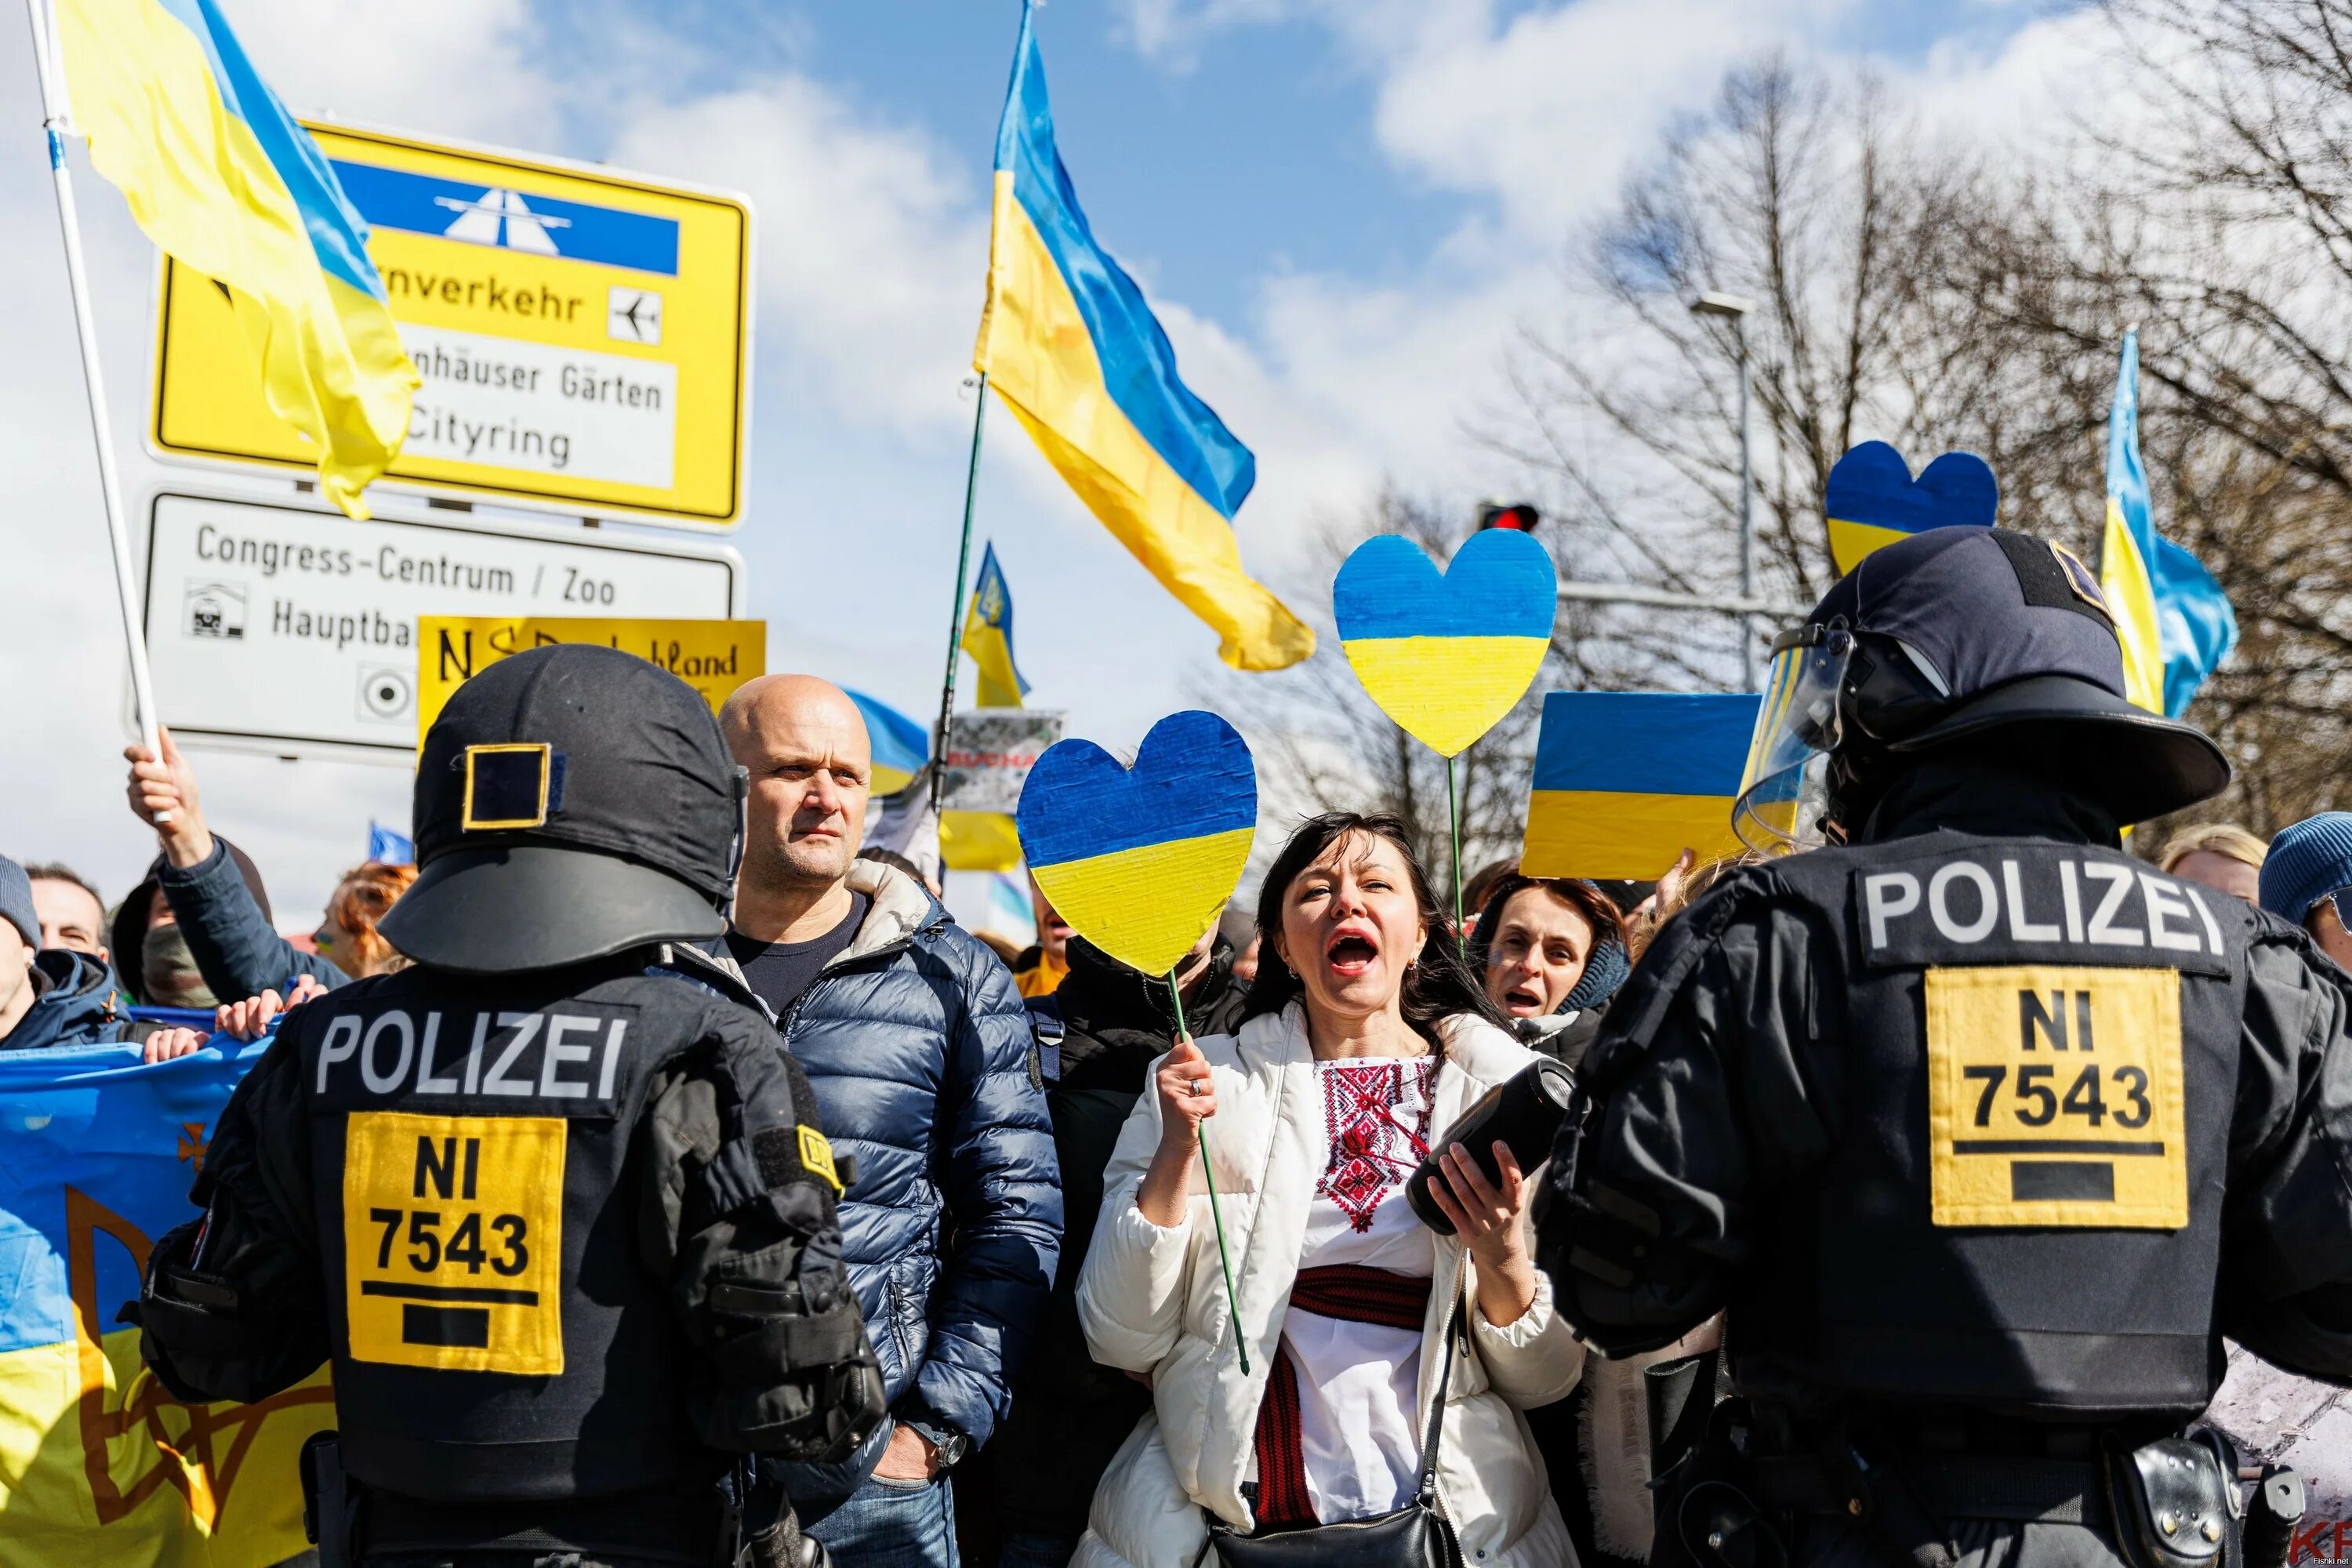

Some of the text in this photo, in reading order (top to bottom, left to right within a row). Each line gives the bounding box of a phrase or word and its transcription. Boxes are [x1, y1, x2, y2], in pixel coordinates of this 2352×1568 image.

[405, 345, 661, 410] nhäuser Gärten
[408, 404, 571, 470] Cityring
[198, 524, 515, 593] Congress-Centrum
[564, 567, 615, 605] Zoo
[274, 600, 419, 649] Hauptba
[947, 751, 1036, 769] BUCHA
[1865, 860, 2223, 956] POLIZEI
[2018, 989, 2094, 1052] NI
[317, 1010, 627, 1099] POLIZEI
[1963, 1063, 2152, 1129] 7543
[412, 1135, 481, 1200] NI
[369, 1207, 529, 1277] 7543
